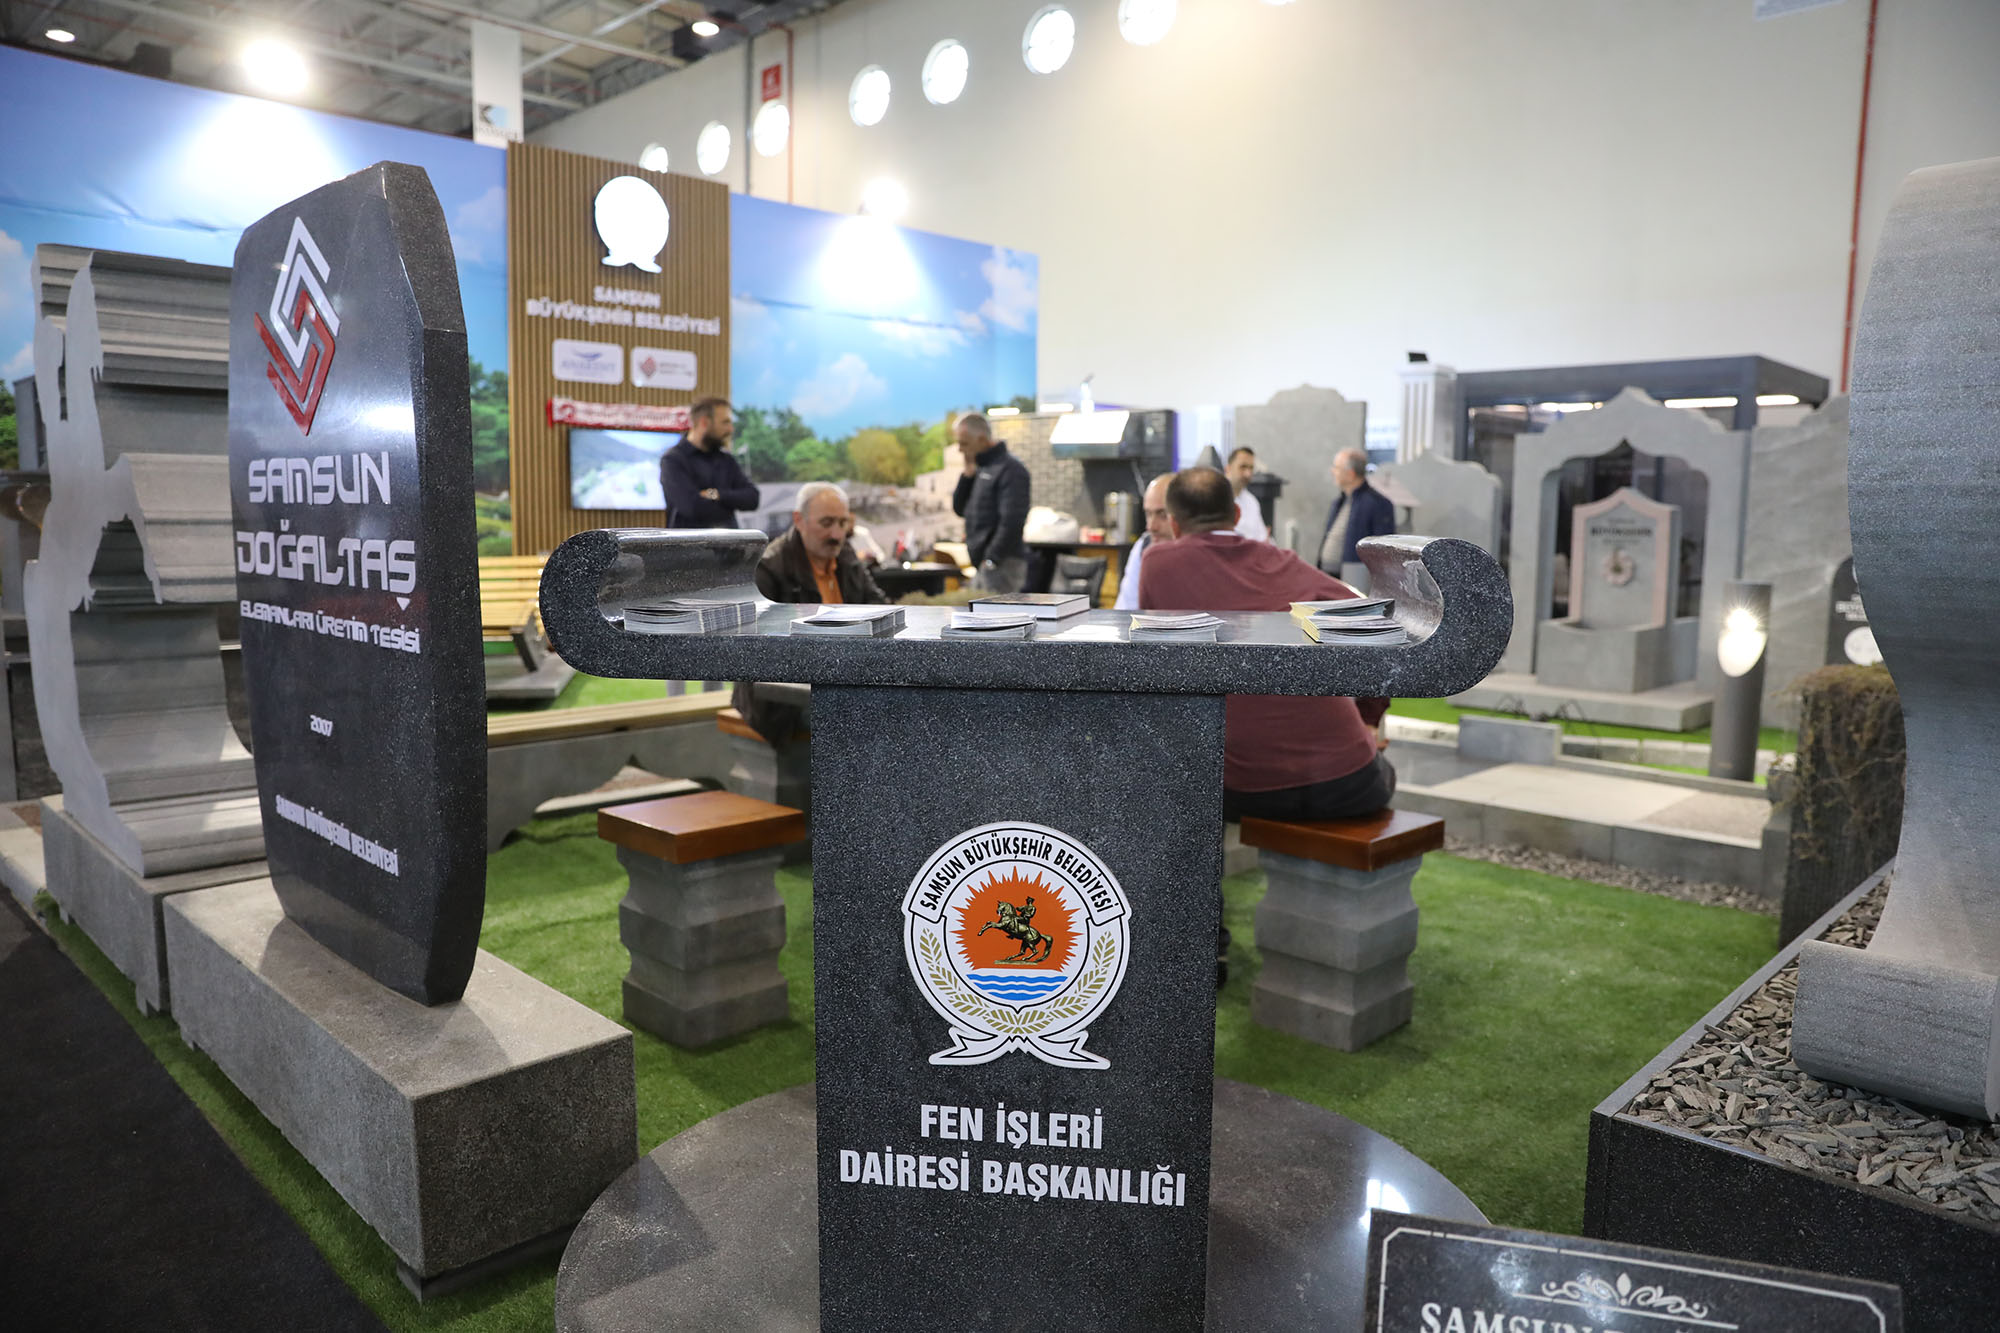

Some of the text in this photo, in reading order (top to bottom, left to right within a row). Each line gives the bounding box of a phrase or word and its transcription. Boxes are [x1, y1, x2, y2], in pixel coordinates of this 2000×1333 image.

[248, 451, 391, 505] SAMSUN
[236, 518, 416, 611] DOĞALTAŞ
[239, 600, 420, 654] ELEMANLARI ÜRETİM TESİSİ
[919, 832, 1120, 913] SAMSUN BÜYÜKŞEHİR BELEDİYESİ
[920, 1102, 1102, 1150] FEN İŞLERİ
[839, 1146, 1186, 1207] DAİRESİ BAŞKANLIĞI
